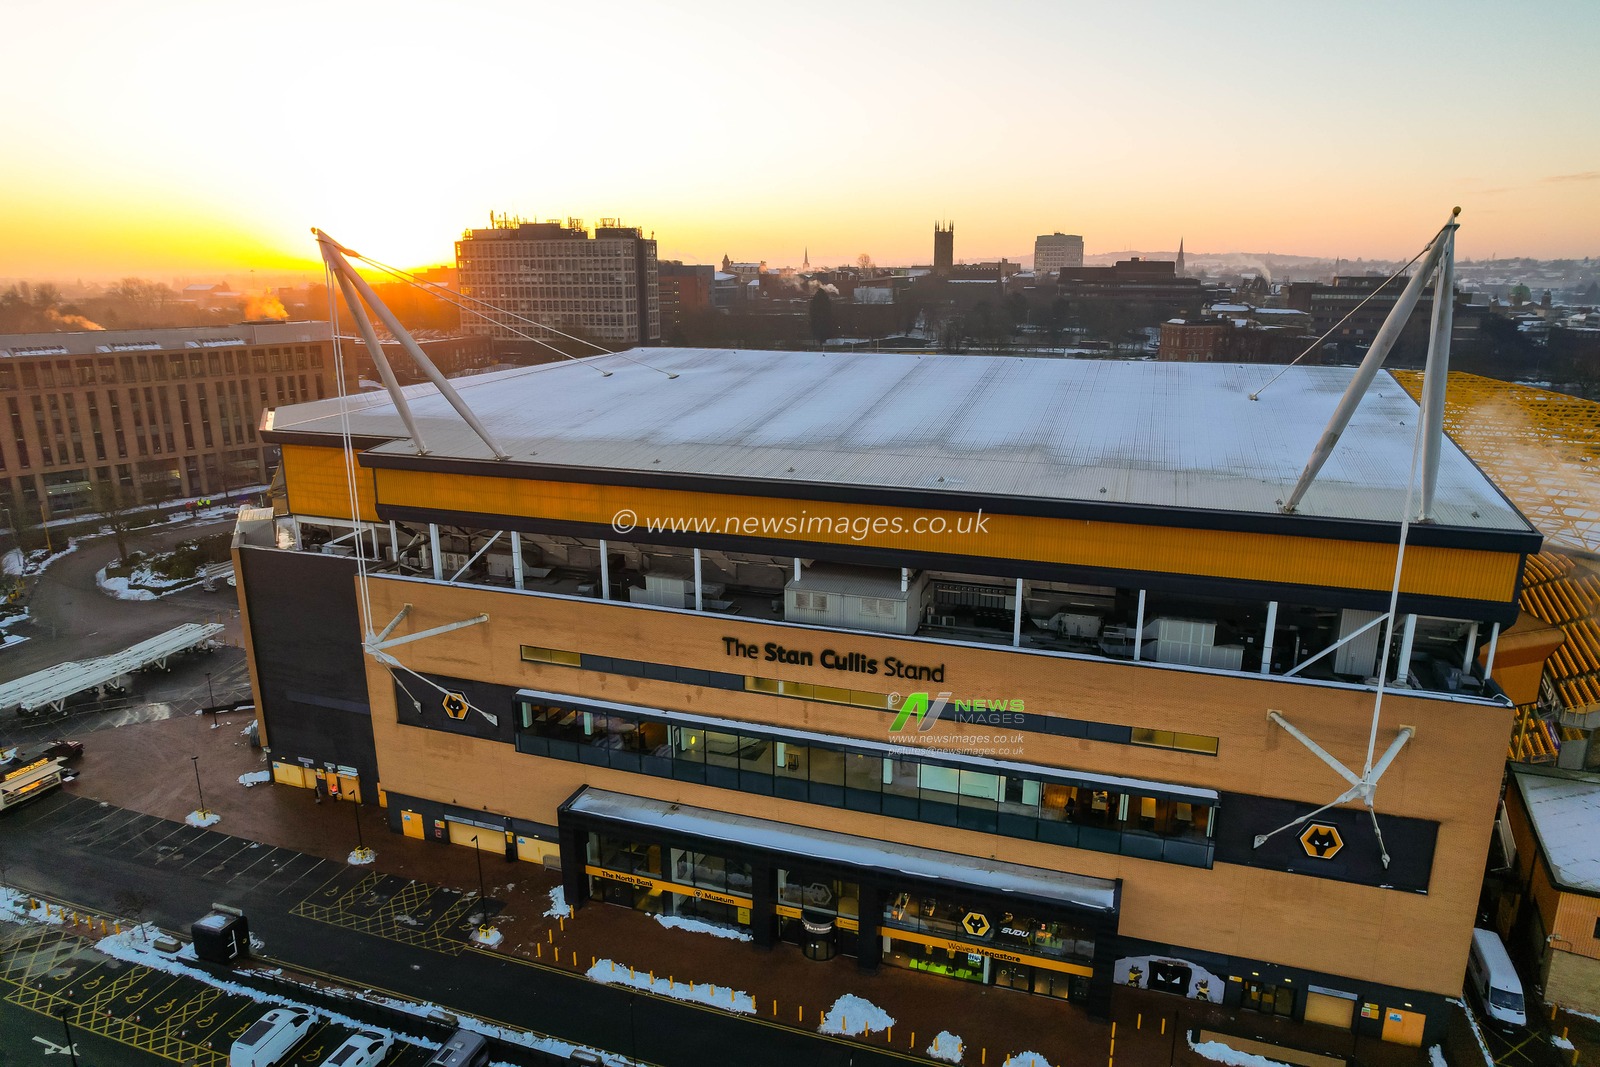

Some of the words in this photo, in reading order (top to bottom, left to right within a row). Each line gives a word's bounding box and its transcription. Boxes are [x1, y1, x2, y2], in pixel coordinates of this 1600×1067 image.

[722, 637, 759, 659] The
[764, 642, 813, 667] Stan
[820, 649, 878, 675] Cullis
[884, 657, 945, 683] Stand
[601, 870, 614, 878] The
[615, 874, 635, 883] North
[636, 878, 653, 887] Bank
[704, 893, 735, 904] Museum
[1001, 927, 1030, 938] SUDU
[948, 942, 974, 953] Wolves
[977, 948, 1020, 962] Megastore
